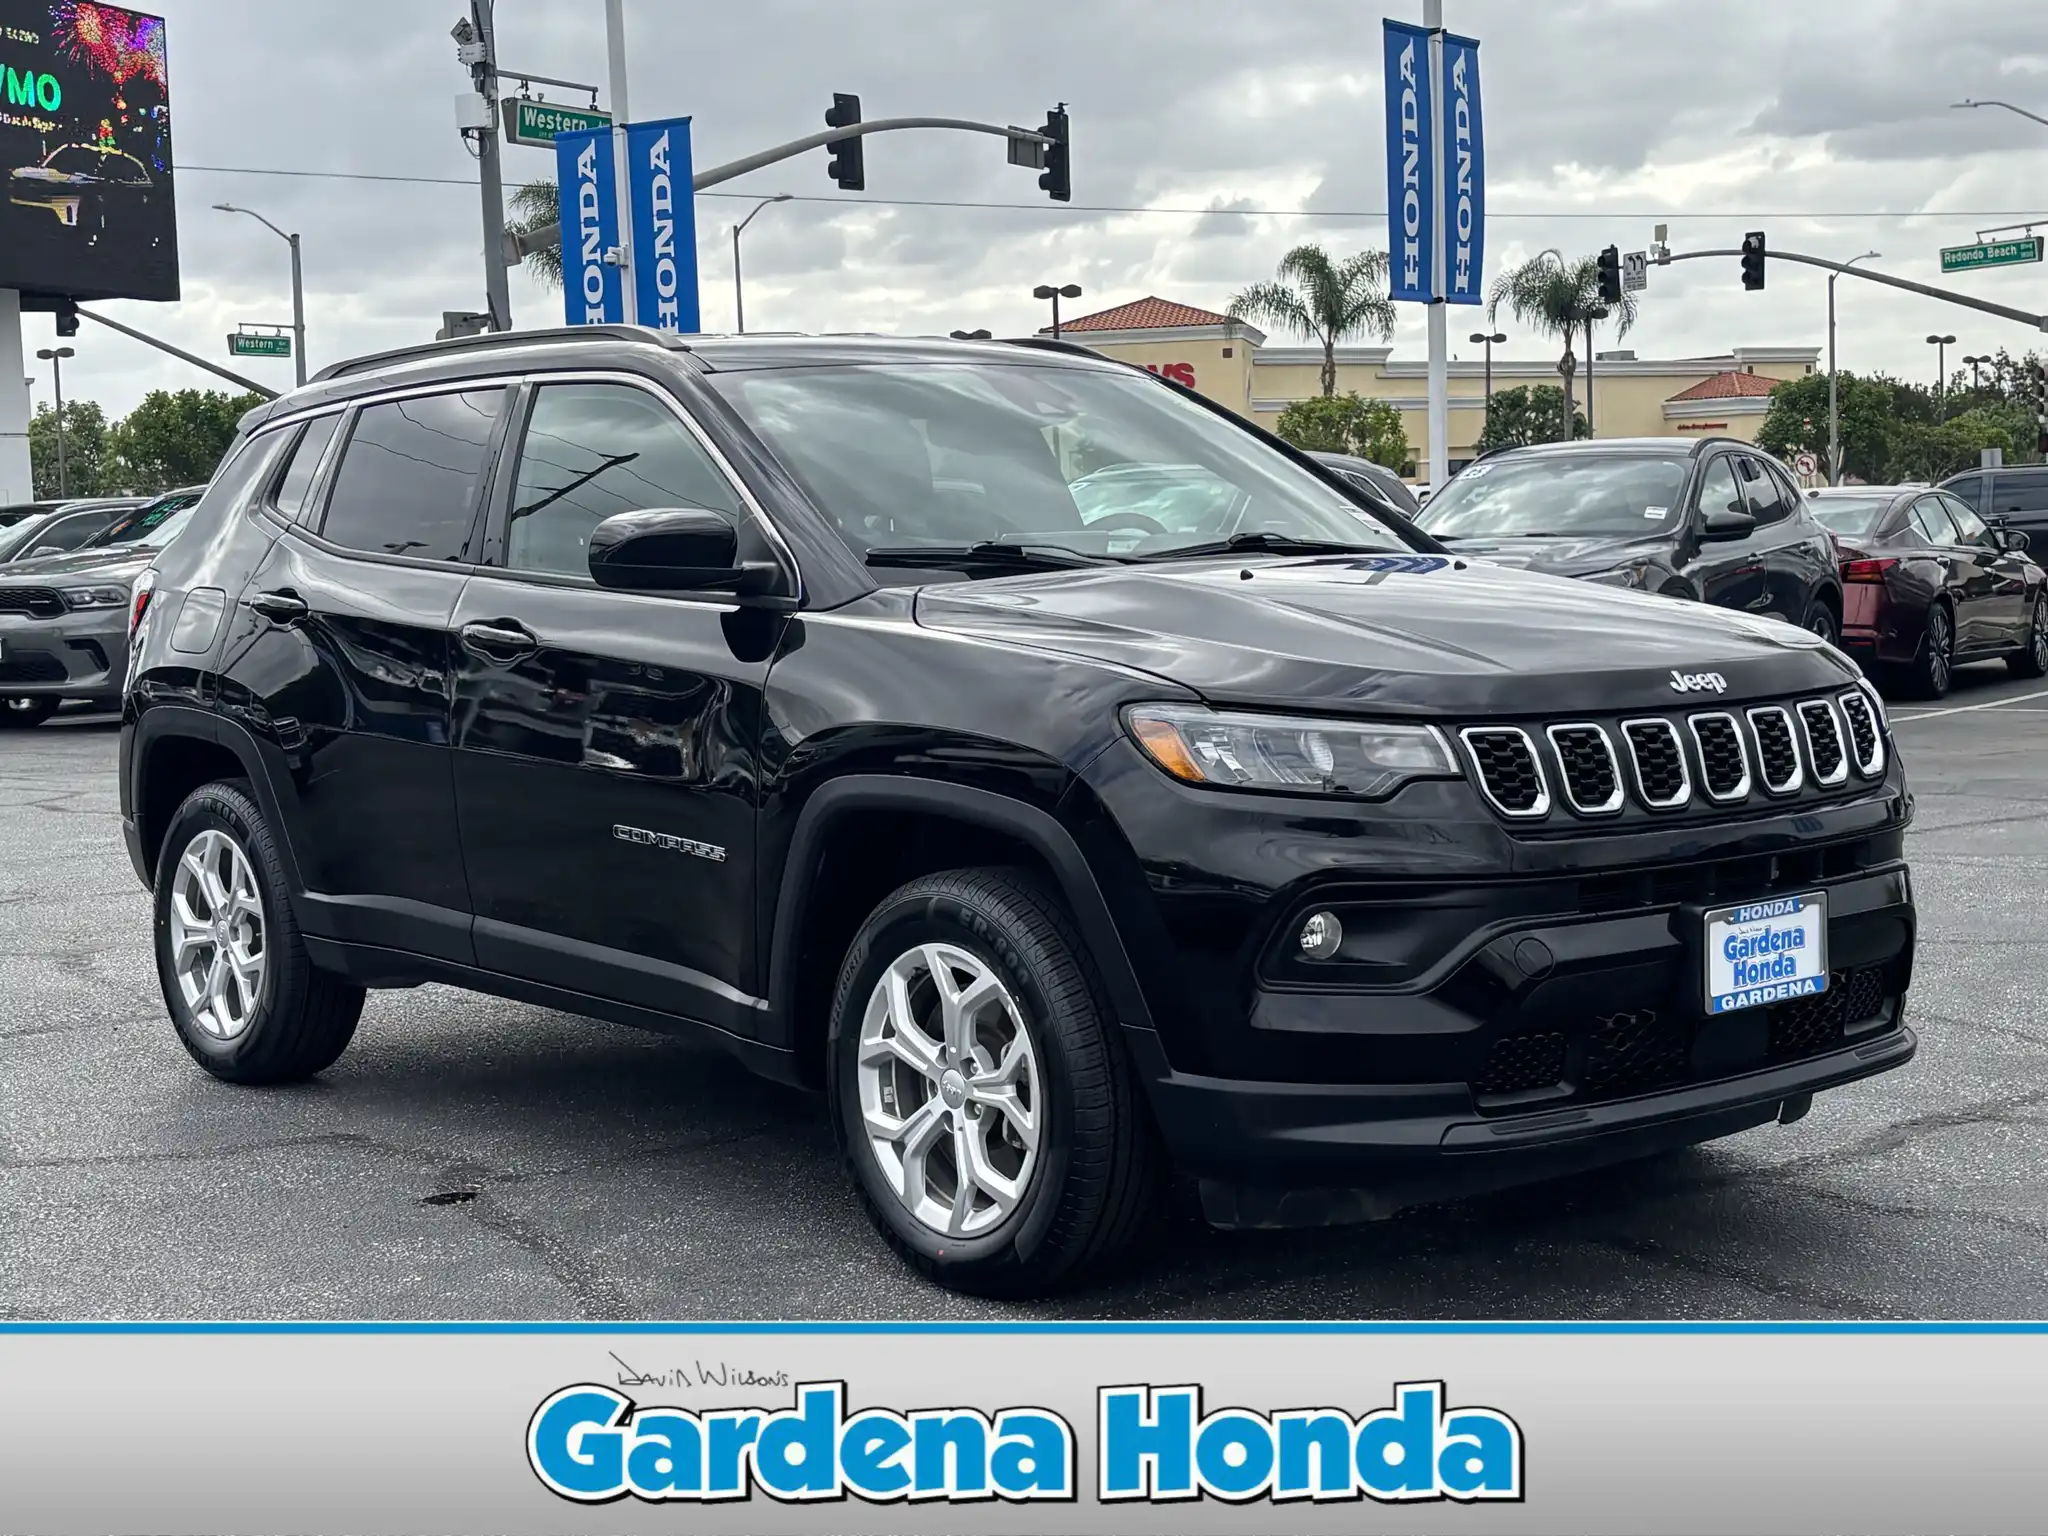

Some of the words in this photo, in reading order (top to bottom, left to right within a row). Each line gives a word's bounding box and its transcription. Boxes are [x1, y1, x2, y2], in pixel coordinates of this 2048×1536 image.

[523, 106, 588, 131] Western
[1400, 37, 1420, 291] HONDA
[1453, 48, 1472, 294] HONDA
[650, 129, 680, 333] HONDA
[1944, 249, 1984, 264] Redondo
[1986, 245, 2017, 258] Beach
[237, 338, 274, 349] Western
[1669, 670, 1727, 694] Jeep
[612, 824, 726, 862] COMPASS
[1739, 900, 1795, 922] HONDA
[1723, 925, 1806, 963] Gardena
[1733, 951, 1797, 990] Honda
[1721, 979, 1817, 1011] GARDENA
